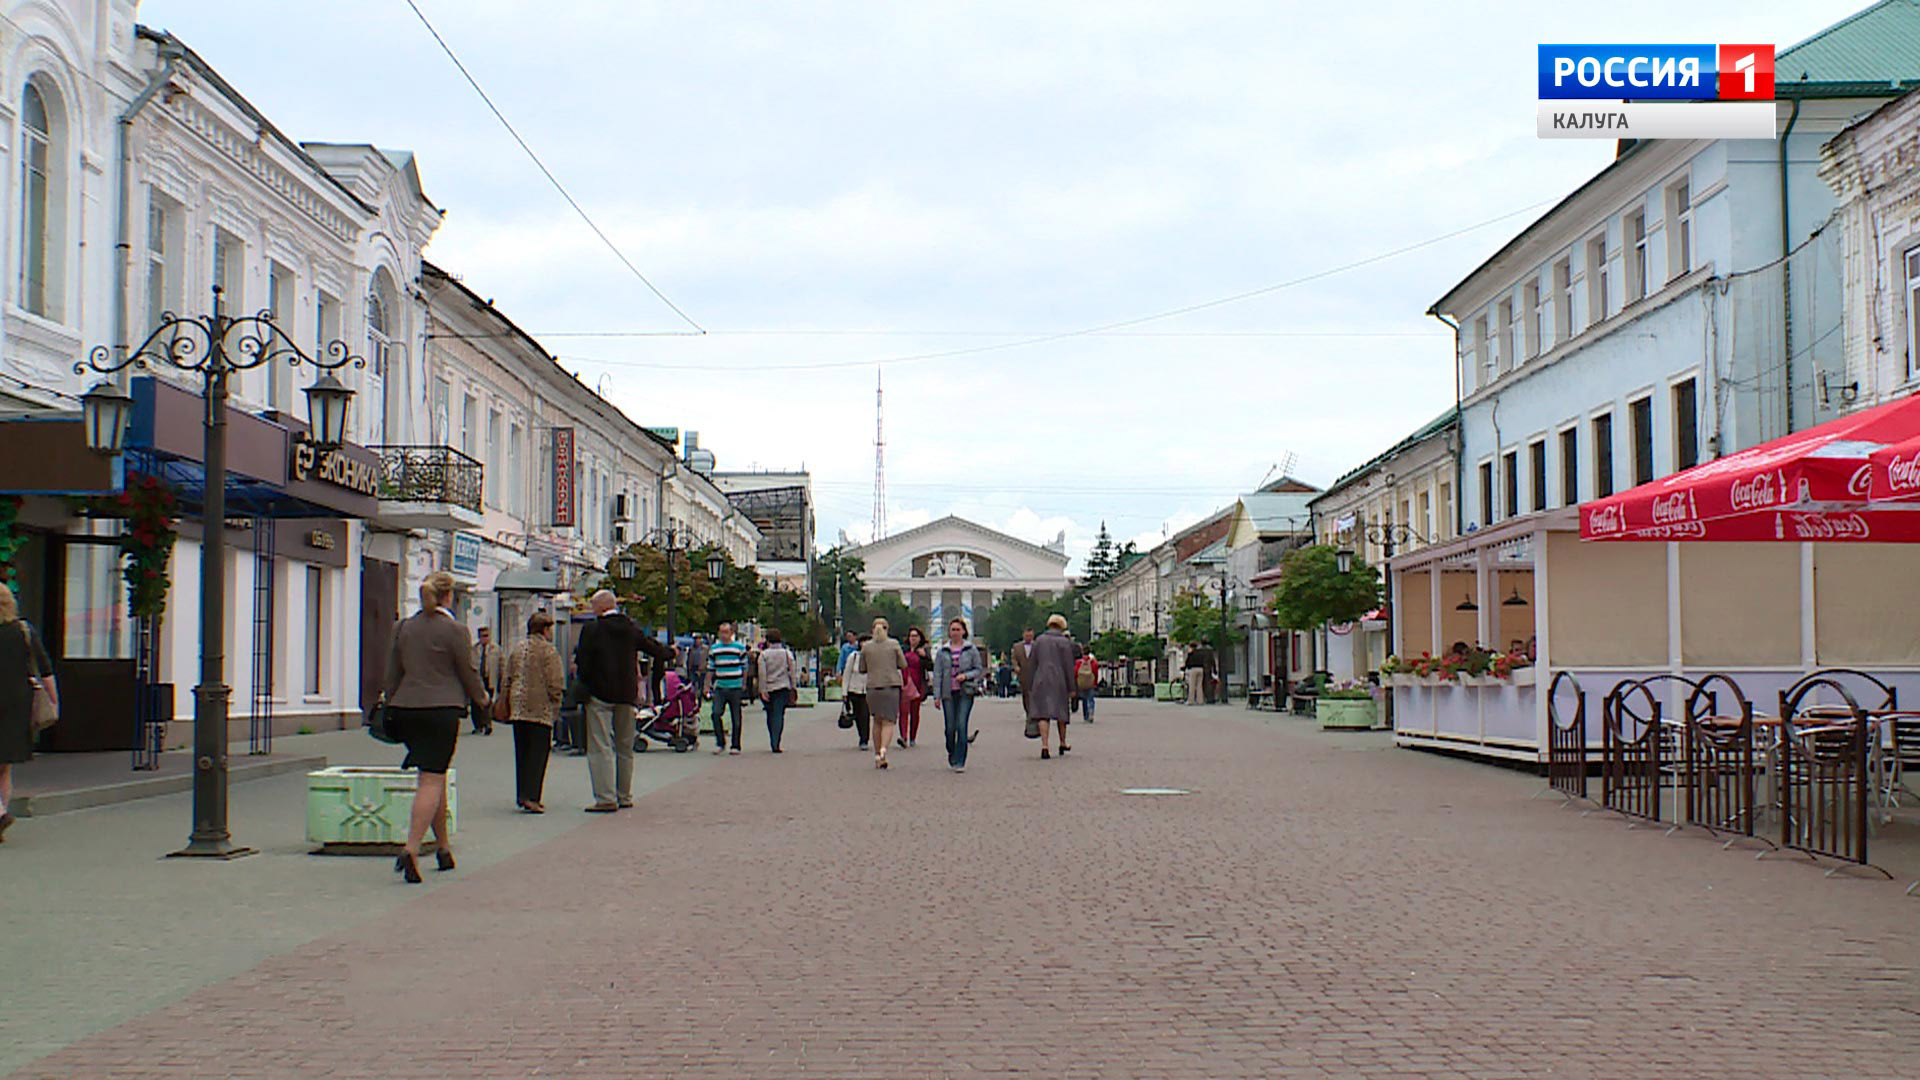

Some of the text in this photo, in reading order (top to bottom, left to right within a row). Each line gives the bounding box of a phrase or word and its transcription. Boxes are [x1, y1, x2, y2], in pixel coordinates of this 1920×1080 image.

[320, 450, 378, 496] ЭКОНИКА
[556, 432, 568, 523] СТОМАТОЛОГИЯ
[1731, 473, 1774, 511] Coca-Cola
[1652, 491, 1687, 525] Coca-Cola
